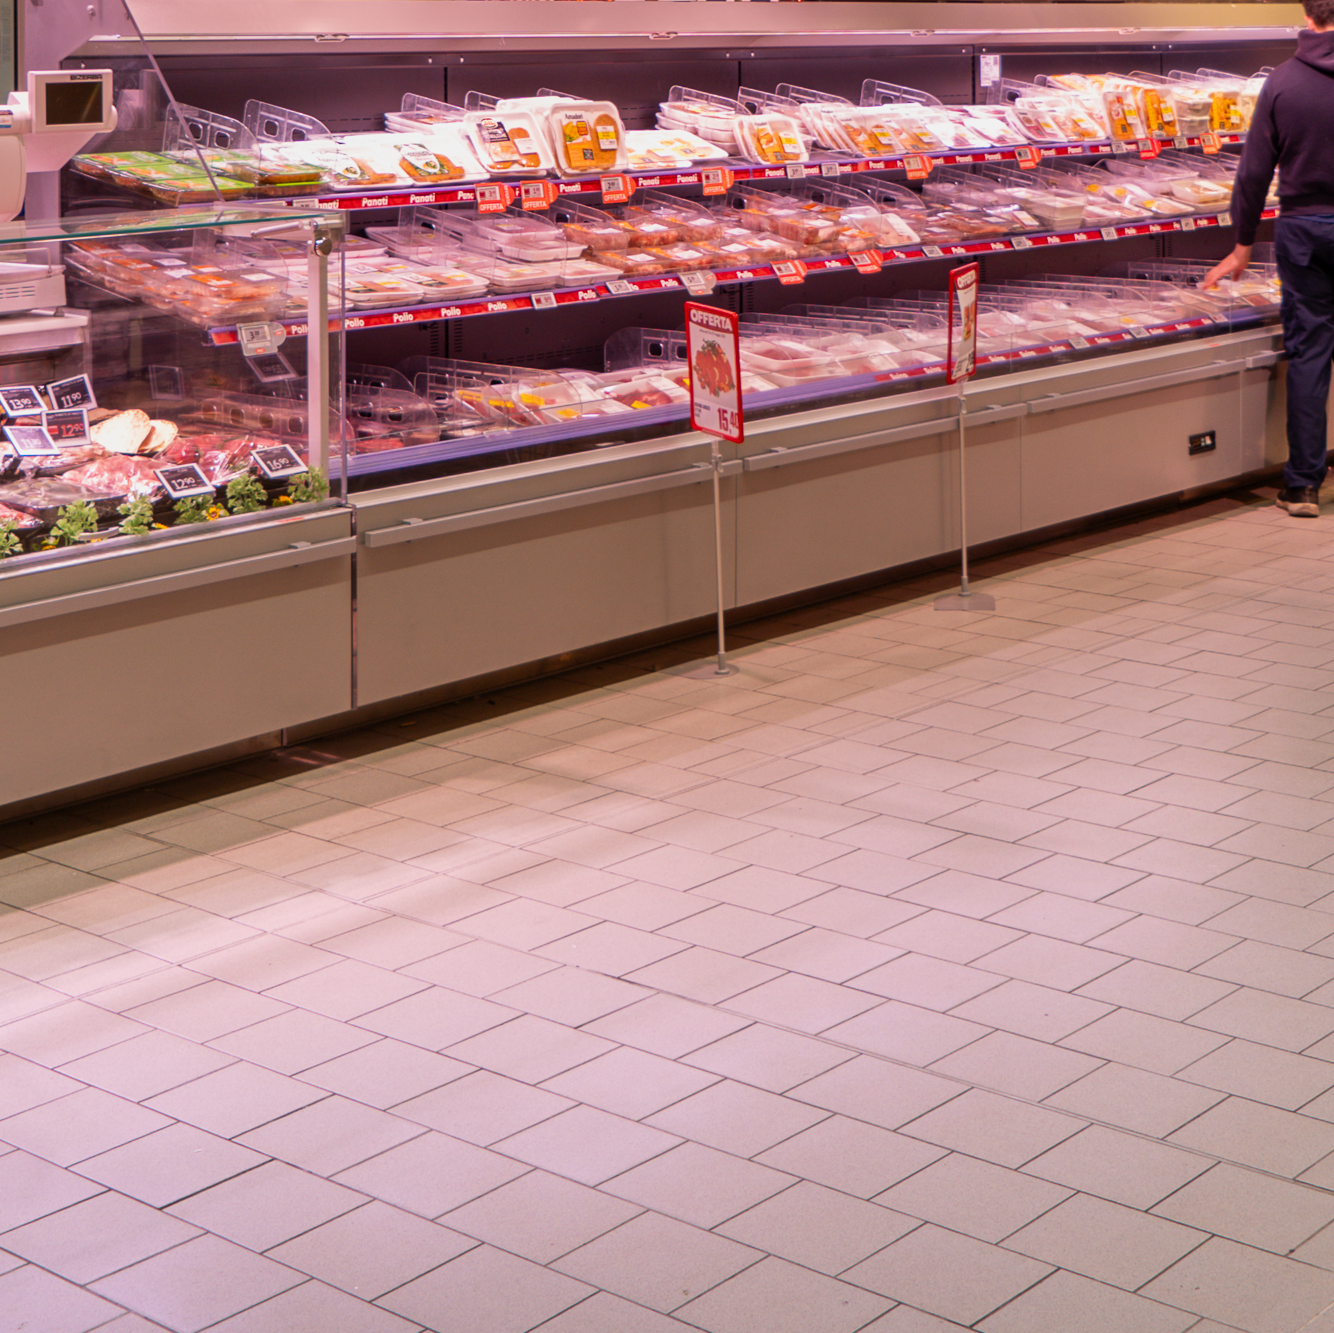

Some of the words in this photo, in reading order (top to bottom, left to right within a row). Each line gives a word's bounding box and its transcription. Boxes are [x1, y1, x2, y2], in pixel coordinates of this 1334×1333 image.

[638, 175, 660, 187] Panati
[676, 172, 698, 184] Panati
[361, 196, 388, 207] Panati
[410, 193, 436, 204] Panati
[559, 182, 581, 193] Panati
[704, 185, 725, 194] OFFERTA
[603, 192, 627, 202] OFFERTA
[480, 202, 504, 212] OFFERTA
[523, 200, 546, 209] OFFERTA
[344, 318, 365, 328] Pollo
[393, 312, 413, 323] Pollo
[441, 306, 461, 316] Pollo
[488, 301, 507, 311] Pollo
[578, 290, 596, 300] Pollo
[690, 308, 732, 331] OFFERTA
